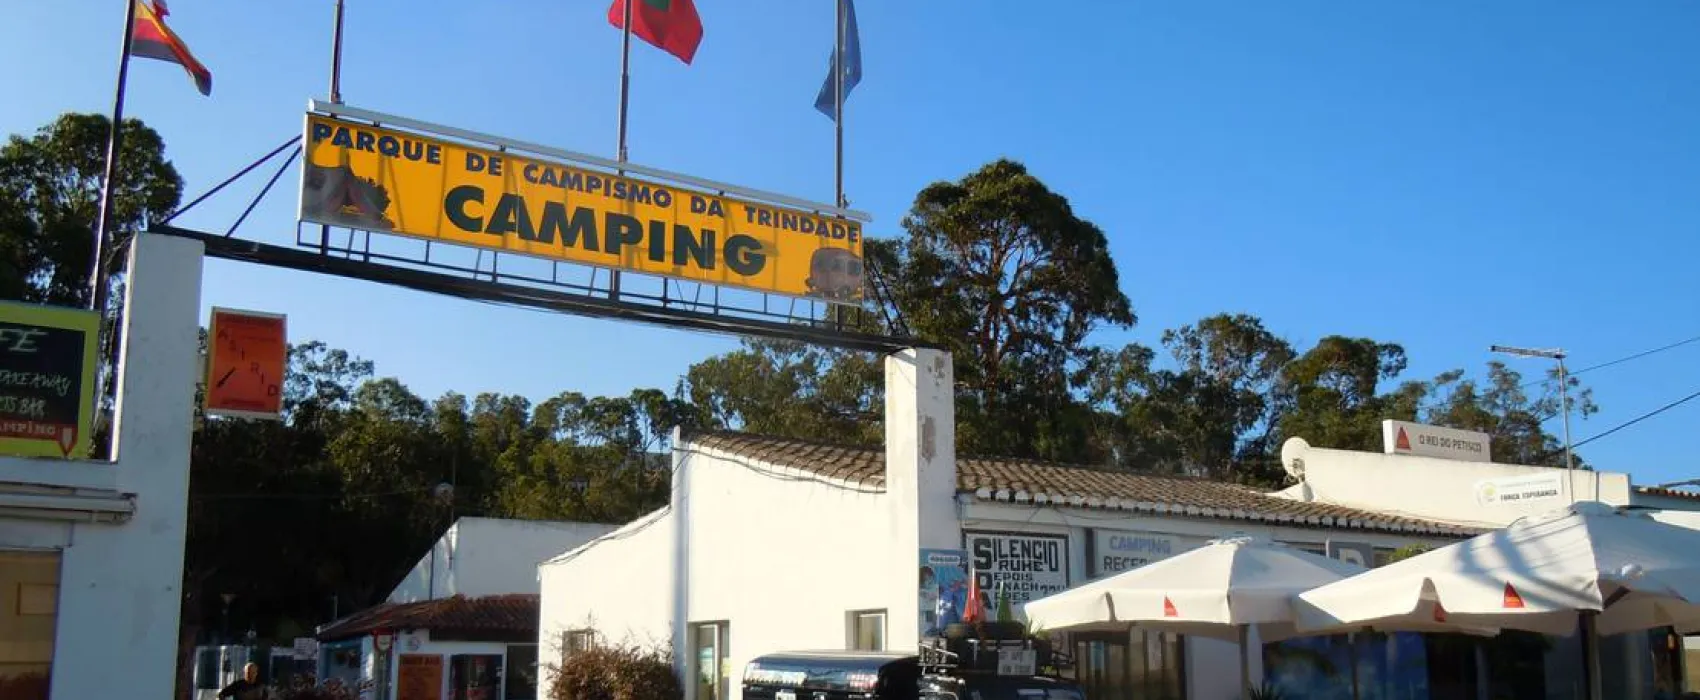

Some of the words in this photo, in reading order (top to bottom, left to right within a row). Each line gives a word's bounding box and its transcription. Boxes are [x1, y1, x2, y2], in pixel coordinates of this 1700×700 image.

[312, 122, 442, 165] PARQUE
[465, 151, 503, 177] DE
[523, 163, 672, 209] CAMPISMO
[690, 195, 724, 218] DA
[743, 204, 859, 243] TRINDADE
[444, 184, 766, 276] CAMPING
[1109, 535, 1172, 556] CAMPING
